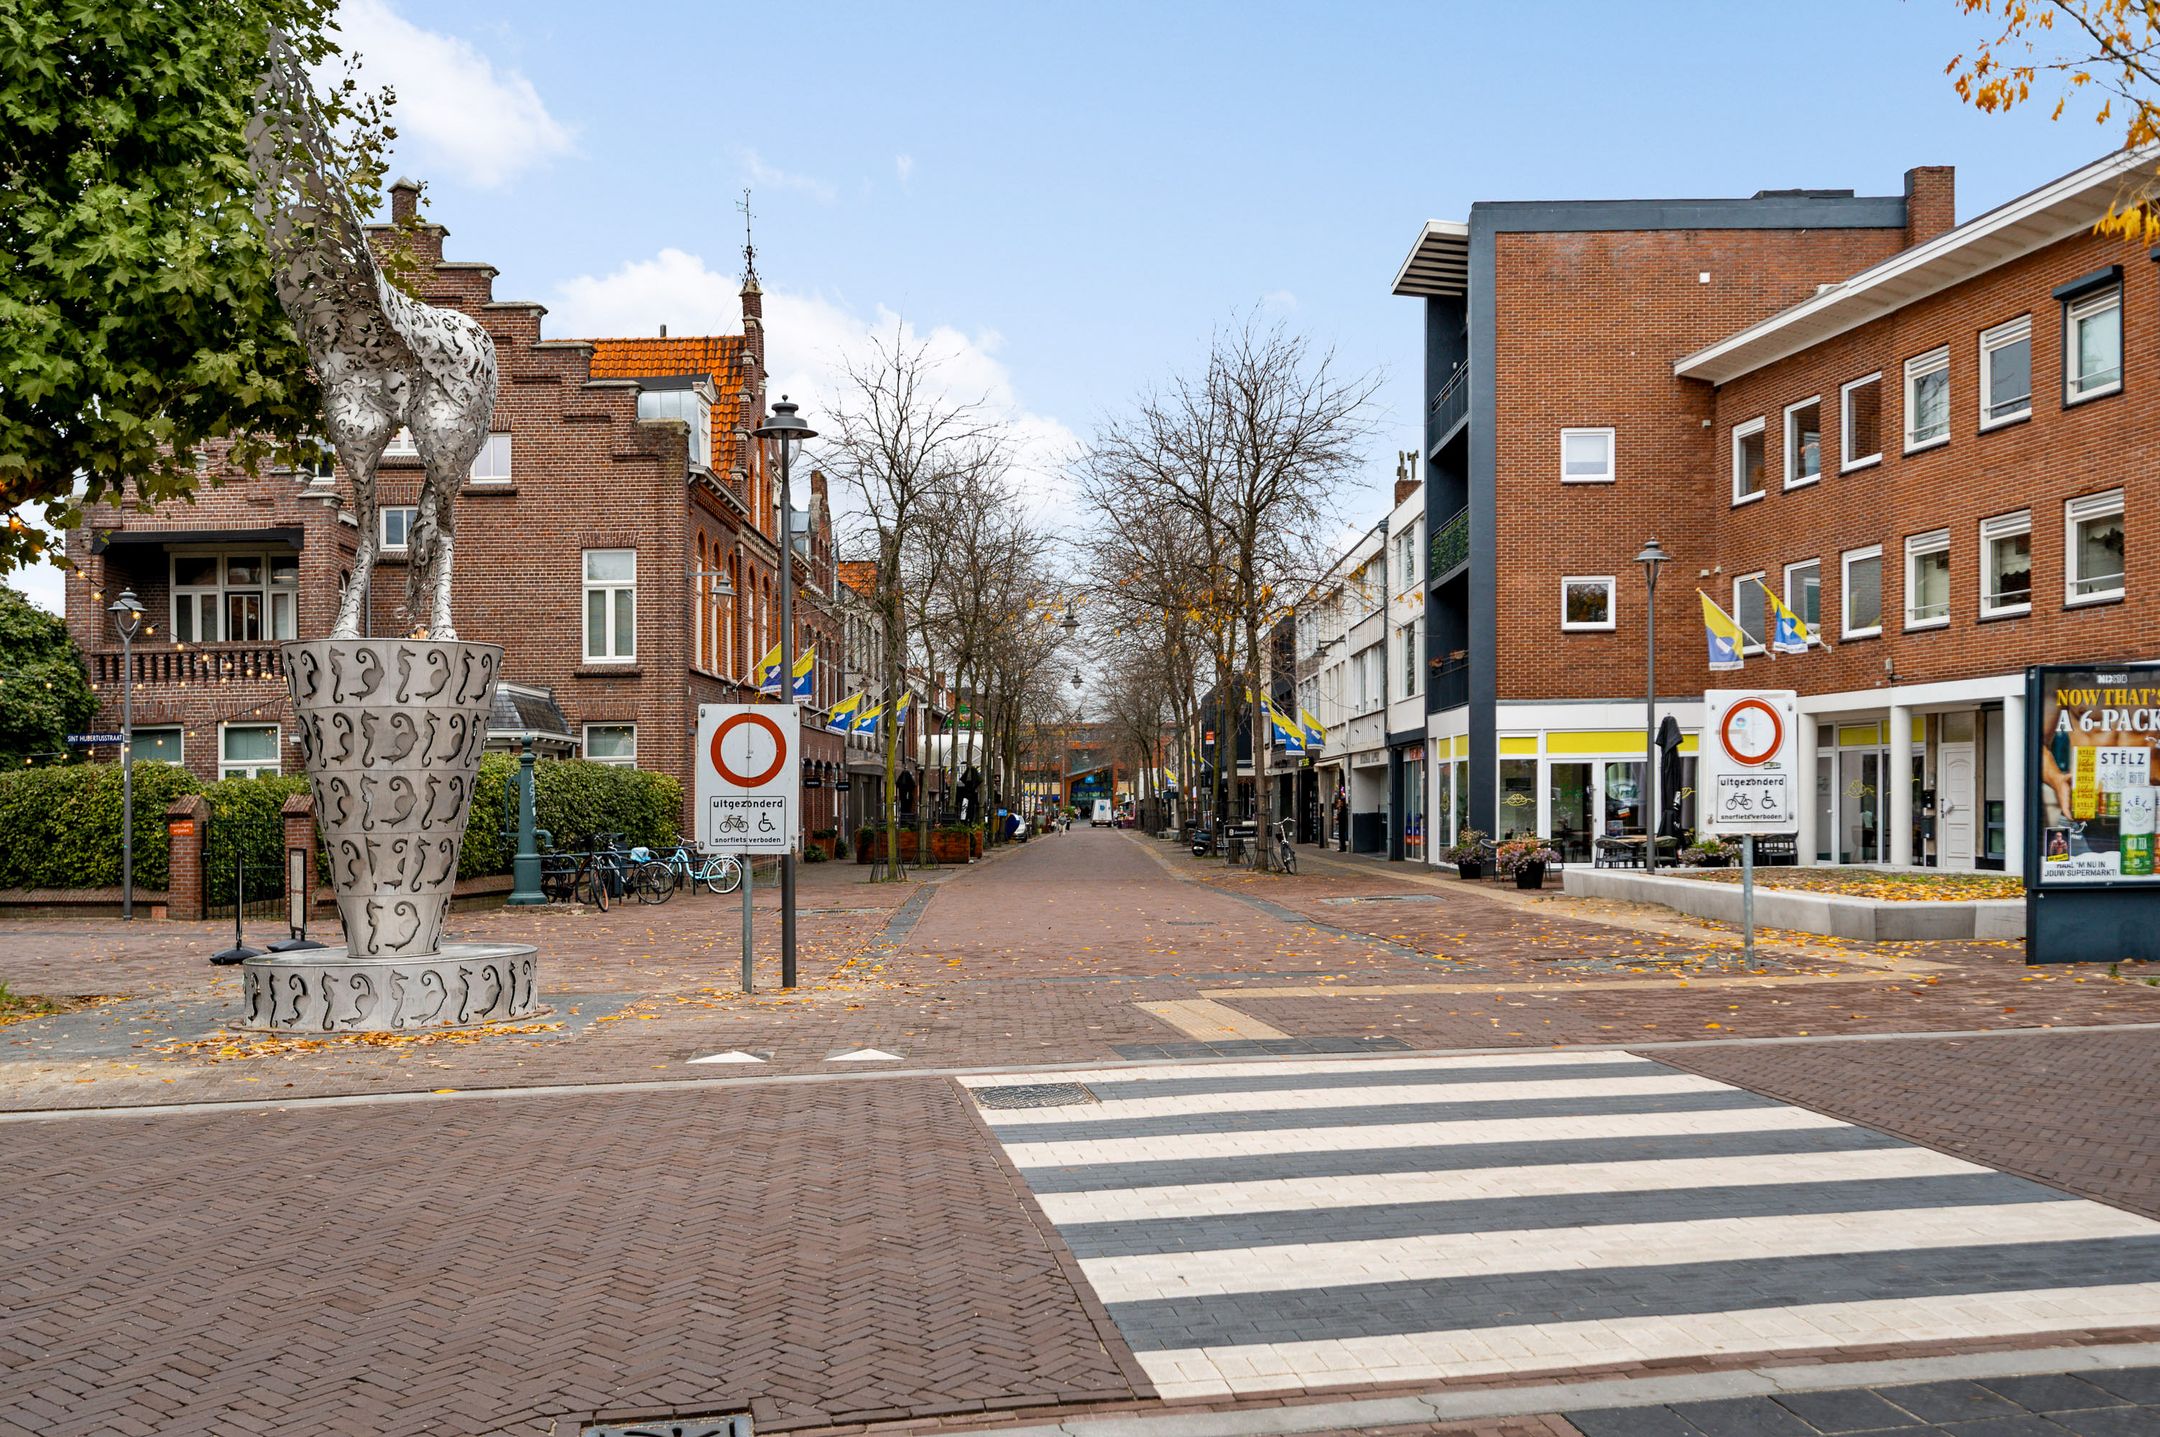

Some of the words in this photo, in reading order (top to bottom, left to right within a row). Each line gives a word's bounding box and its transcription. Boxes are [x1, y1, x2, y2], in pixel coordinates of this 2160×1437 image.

[2056, 688, 2100, 706] NOW
[2055, 709, 2073, 731] A
[2101, 750, 2145, 765] STËLZ
[1720, 778, 1784, 788] uitgezonderd
[713, 799, 783, 810] uitgezonderd
[2045, 869, 2065, 877] JOUW
